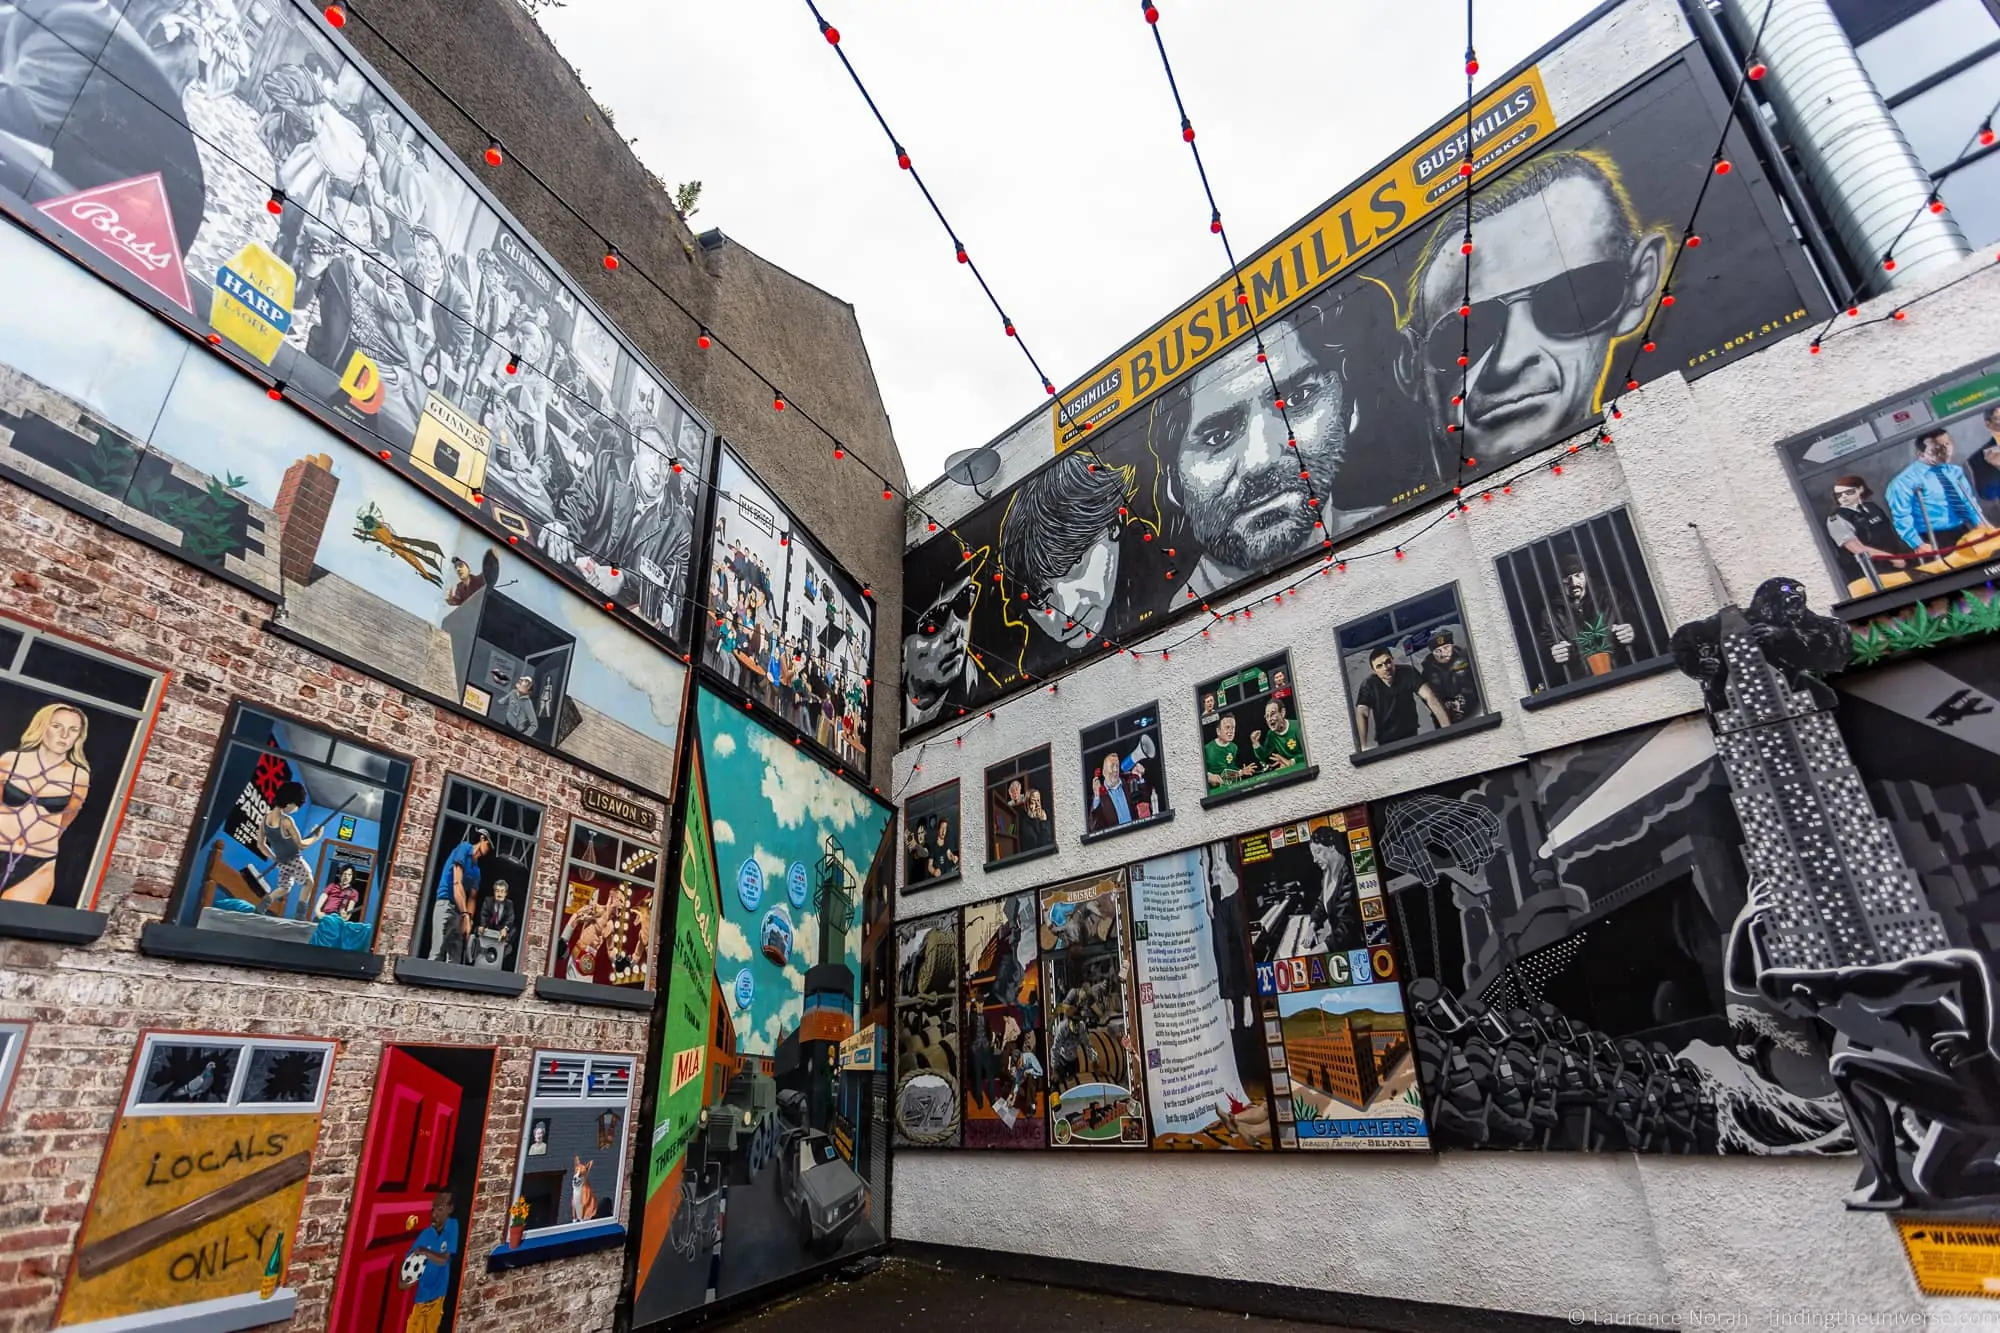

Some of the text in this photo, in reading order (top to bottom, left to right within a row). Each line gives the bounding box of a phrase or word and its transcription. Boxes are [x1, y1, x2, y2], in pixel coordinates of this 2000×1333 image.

[1418, 92, 1529, 179] BUSHMILLS
[1471, 131, 1527, 171] WHISKEY
[72, 201, 173, 271] Bass
[248, 271, 276, 298] KEG
[500, 232, 552, 292] GUINNESS
[223, 272, 285, 322] HARP
[1128, 179, 1406, 400] BUSHMILLS
[223, 298, 270, 337] LAGER
[1060, 374, 1119, 423] BUSHMILLS
[429, 401, 487, 447] GUINNESS
[588, 791, 637, 820] LISAVON
[1256, 949, 1394, 992] TOBACCO
[677, 1051, 700, 1087] MLA
[145, 1134, 288, 1187] LOCALS
[169, 1224, 271, 1282] ONLY
